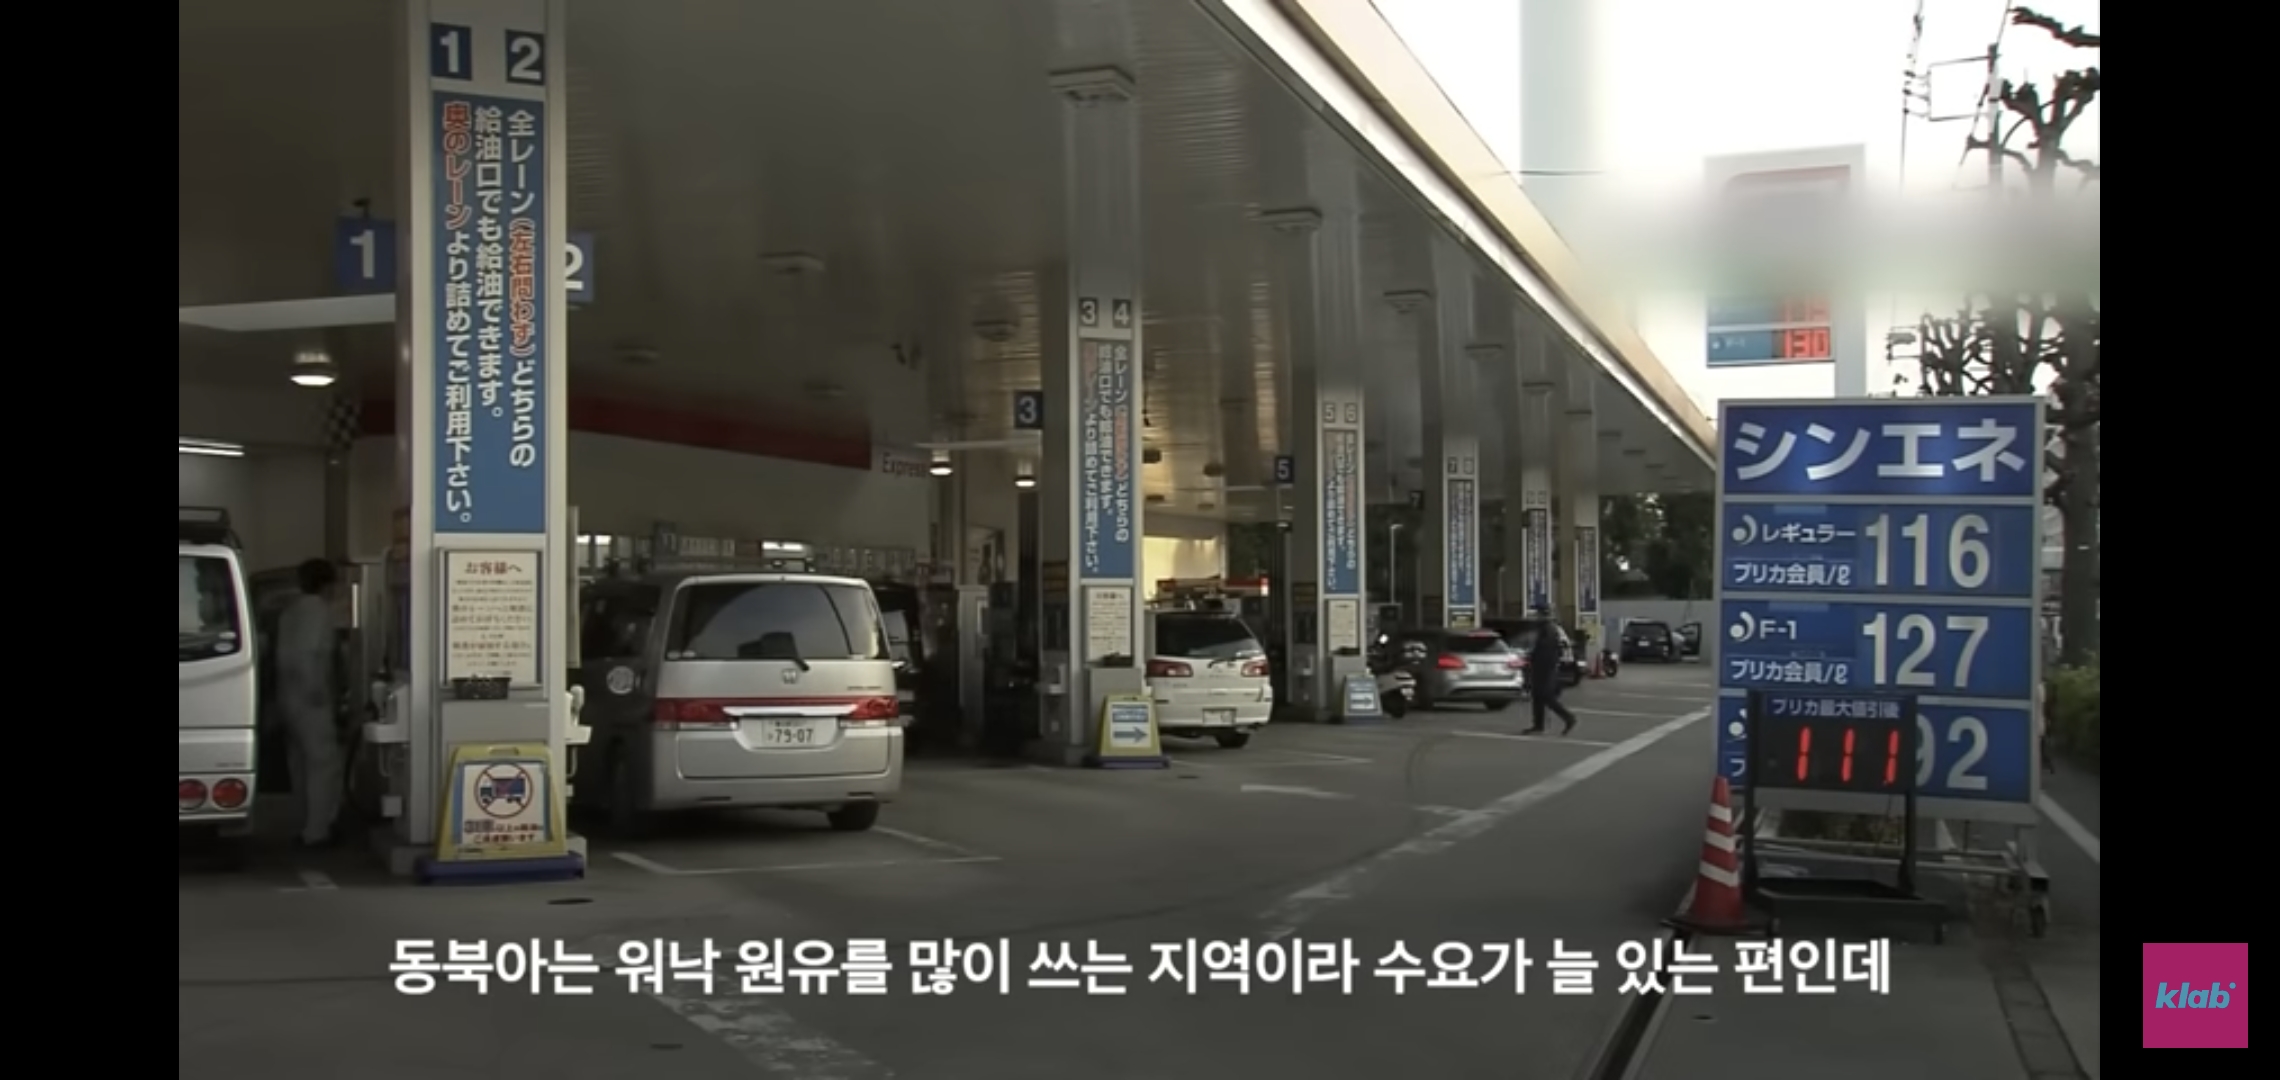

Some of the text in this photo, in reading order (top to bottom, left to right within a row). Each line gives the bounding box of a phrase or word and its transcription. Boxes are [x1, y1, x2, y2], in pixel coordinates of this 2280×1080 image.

[439, 31, 459, 73] 1
[510, 36, 542, 80] 2
[350, 229, 376, 279] 1
[475, 107, 503, 417] 給油口でも給油できます。
[565, 243, 584, 290] 2
[443, 101, 472, 523] 奥のレーンより詰めてご利用下さい。
[1081, 301, 1096, 325] 3
[1114, 302, 1129, 325] 4
[1019, 396, 1037, 424] 3
[1325, 404, 1334, 420] 5
[1277, 459, 1290, 480] 5
[1733, 418, 2025, 483] シンエネ
[1762, 523, 1857, 543] レギュラー
[1865, 513, 1991, 589] 116
[1759, 619, 1798, 640] F-1
[1863, 611, 1990, 688] 127
[1796, 726, 1899, 784] 111
